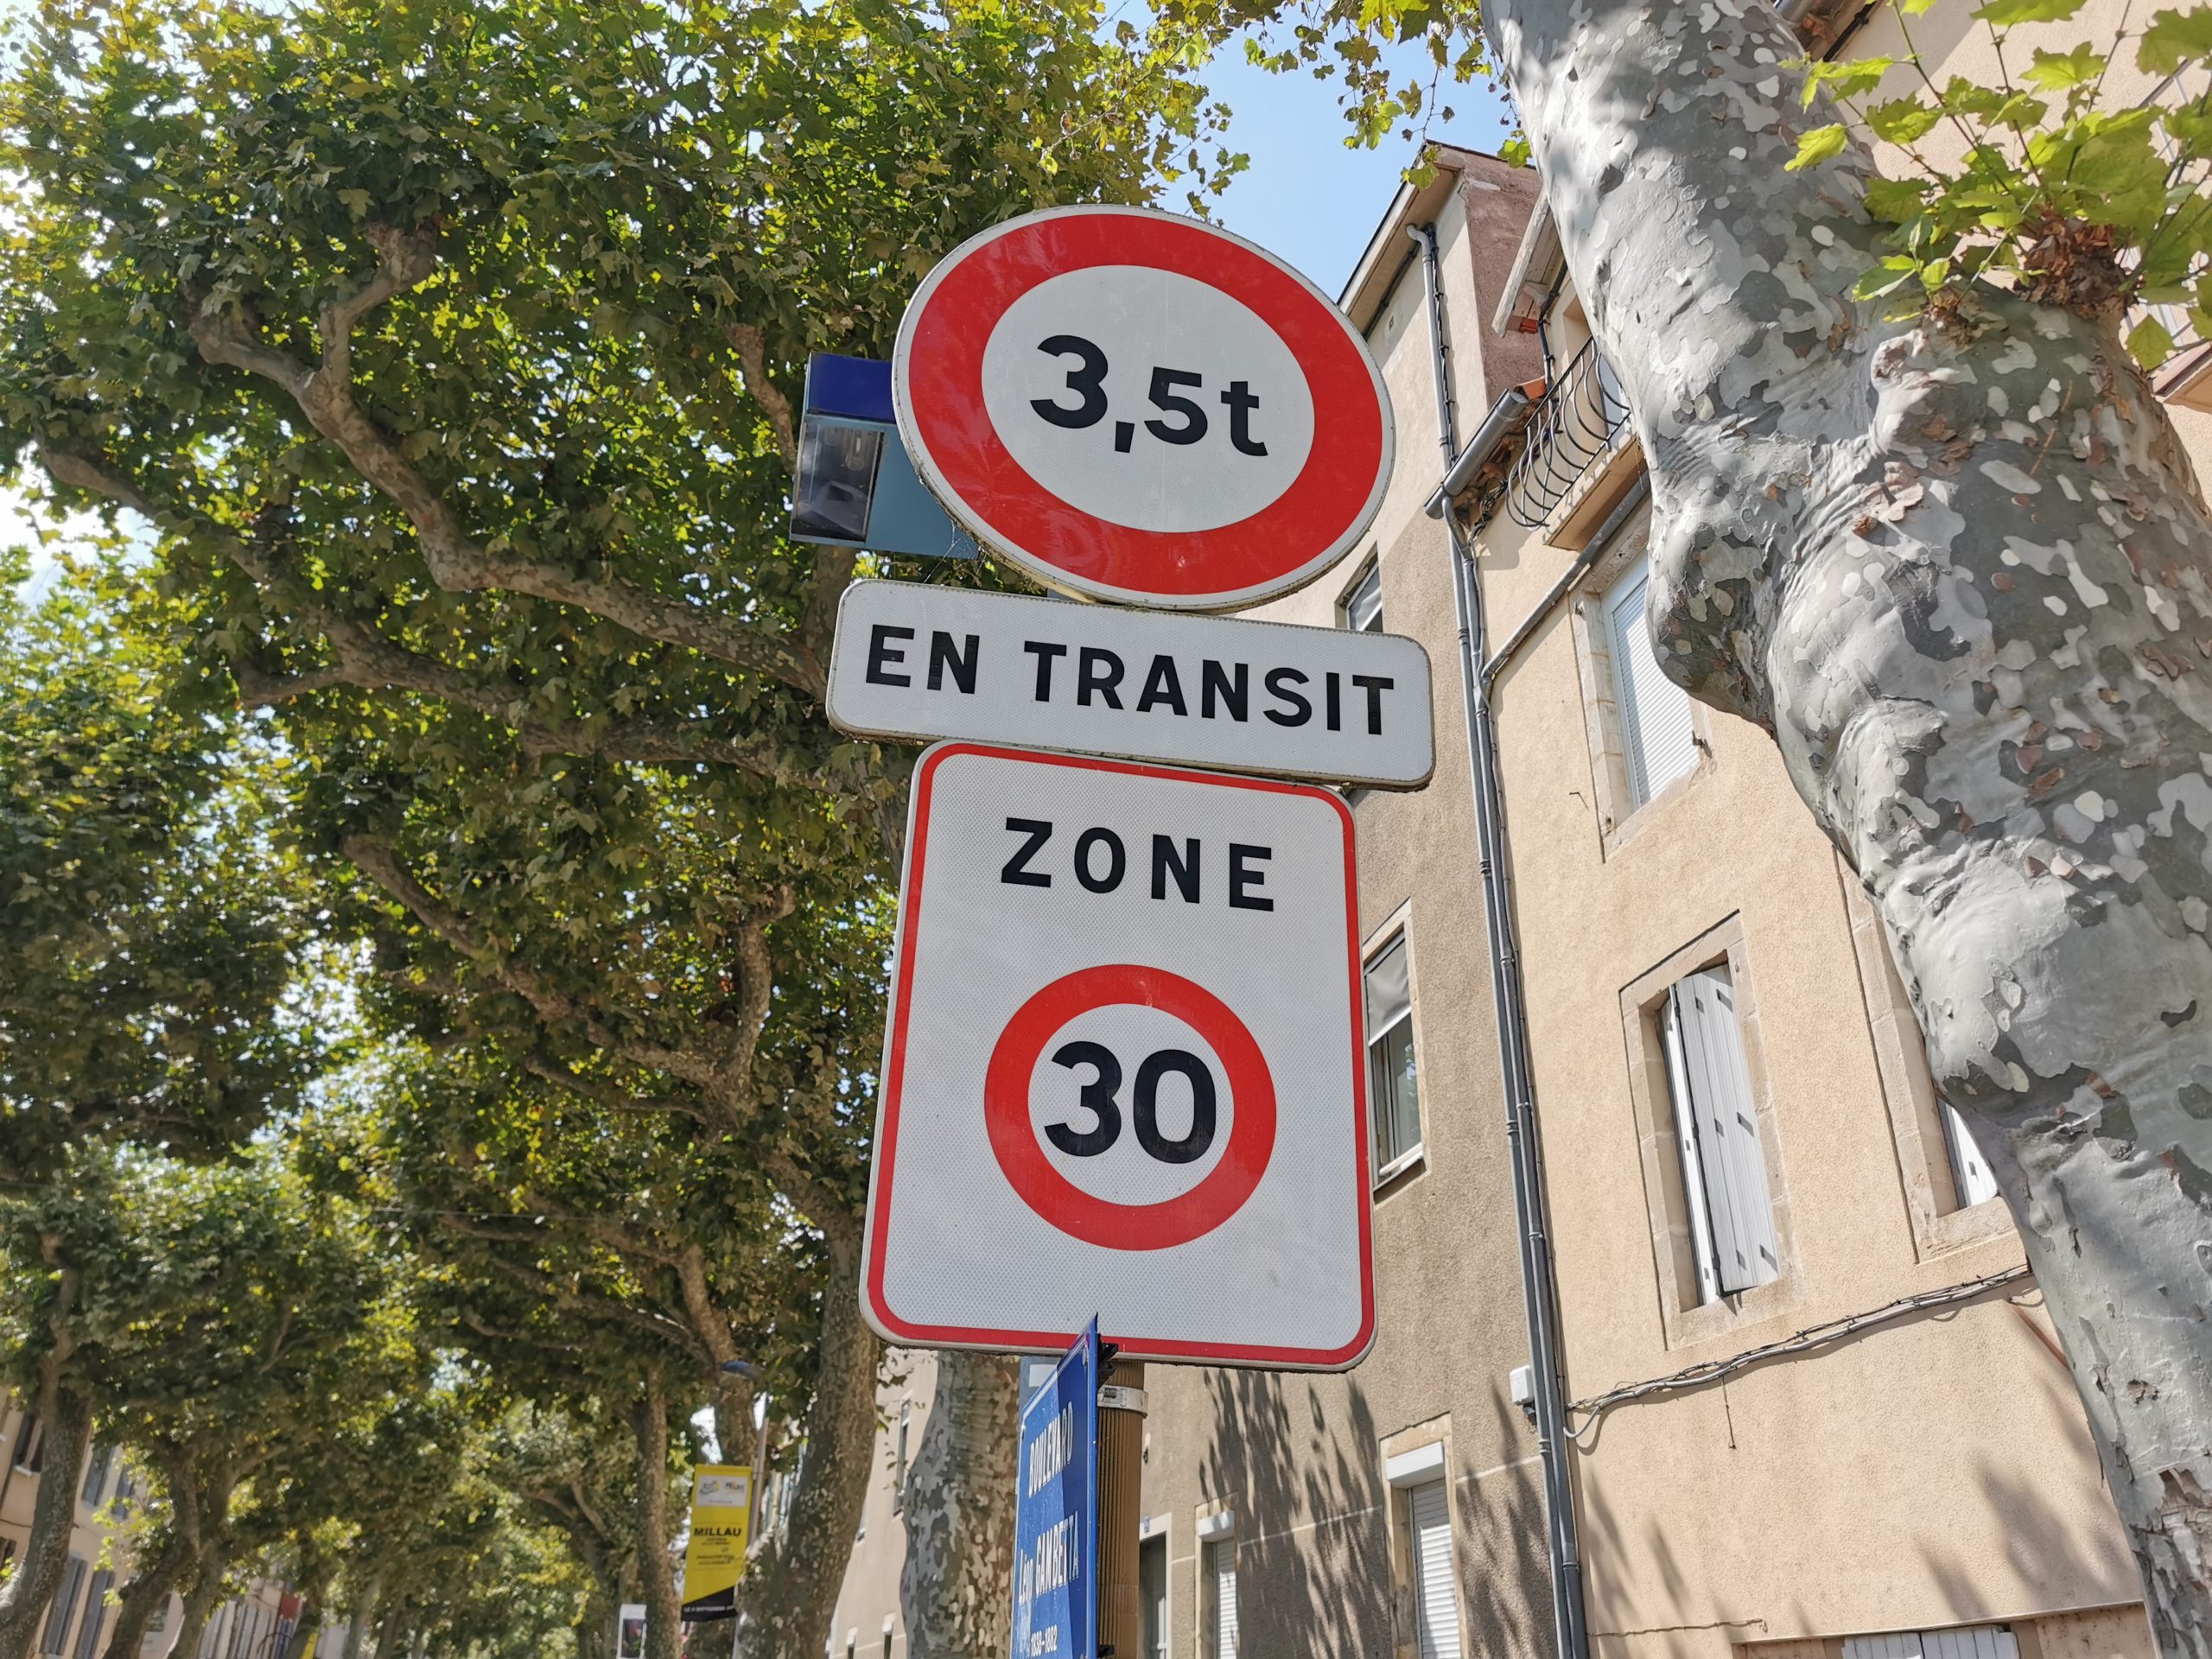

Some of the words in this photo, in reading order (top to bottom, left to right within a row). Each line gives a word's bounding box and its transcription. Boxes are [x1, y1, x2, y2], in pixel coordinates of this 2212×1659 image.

[865, 624, 980, 695] EN
[1024, 641, 1395, 735] TRANSIT
[1001, 817, 1274, 912] ZONE
[1044, 1040, 1217, 1164] 30
[1028, 1401, 1073, 1498] BOULEVARD
[694, 1527, 741, 1536] MILLAU
[1019, 1548, 1033, 1606] Léon
[1036, 1510, 1079, 1599] GAMBETTA
